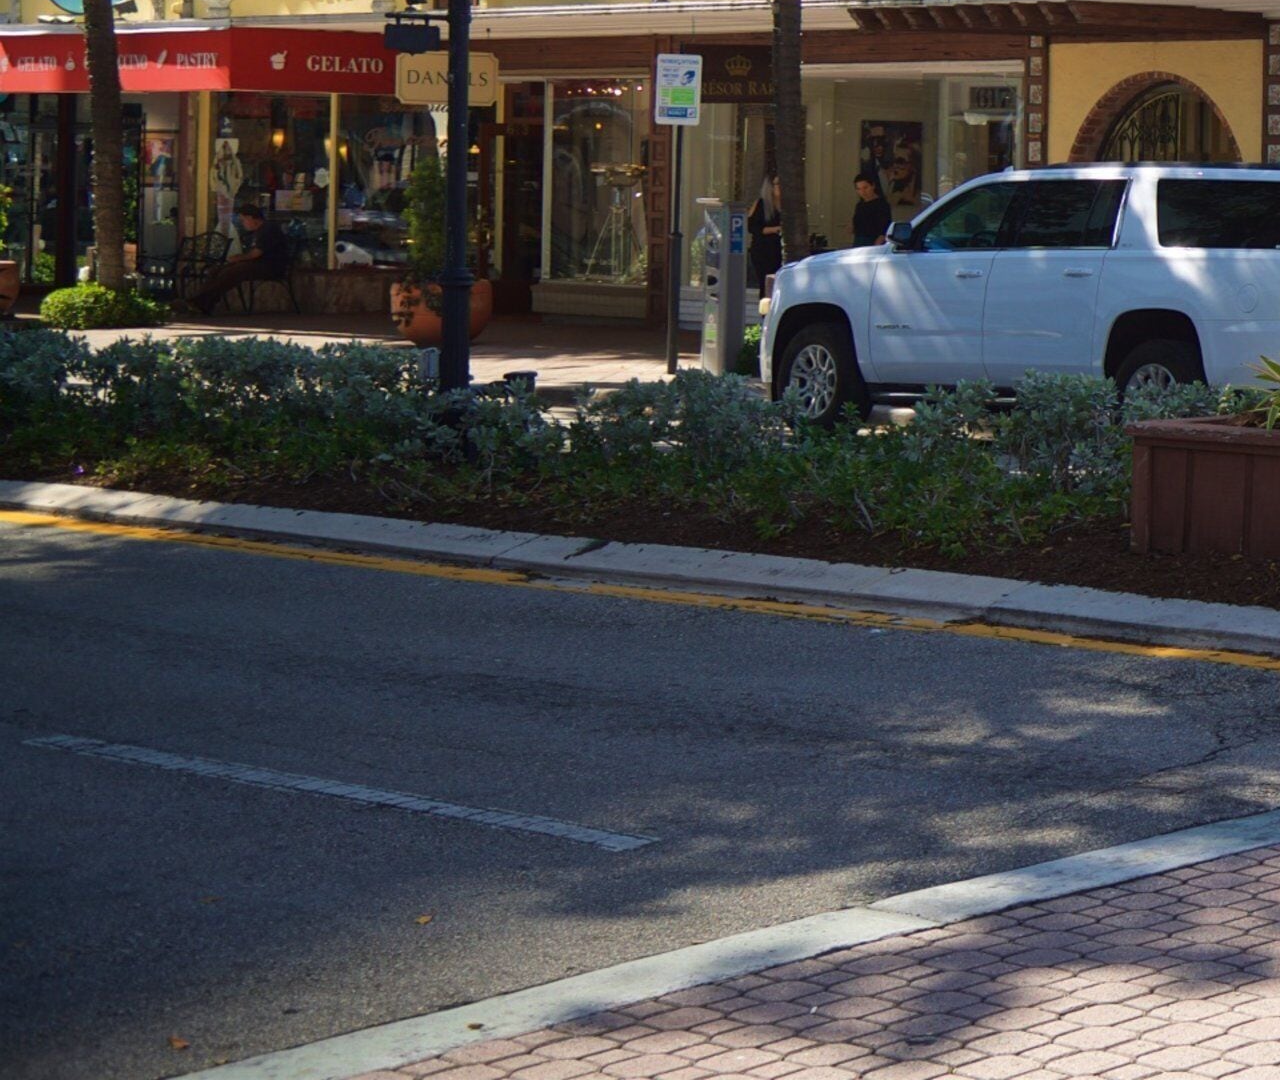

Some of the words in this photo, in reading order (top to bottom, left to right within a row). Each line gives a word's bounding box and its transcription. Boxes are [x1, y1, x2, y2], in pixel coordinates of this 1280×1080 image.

[17, 56, 57, 71] GELATO
[176, 53, 219, 69] PASTRY
[306, 54, 384, 74] GELATO
[407, 69, 488, 87] DANLS
[731, 218, 742, 232] P
